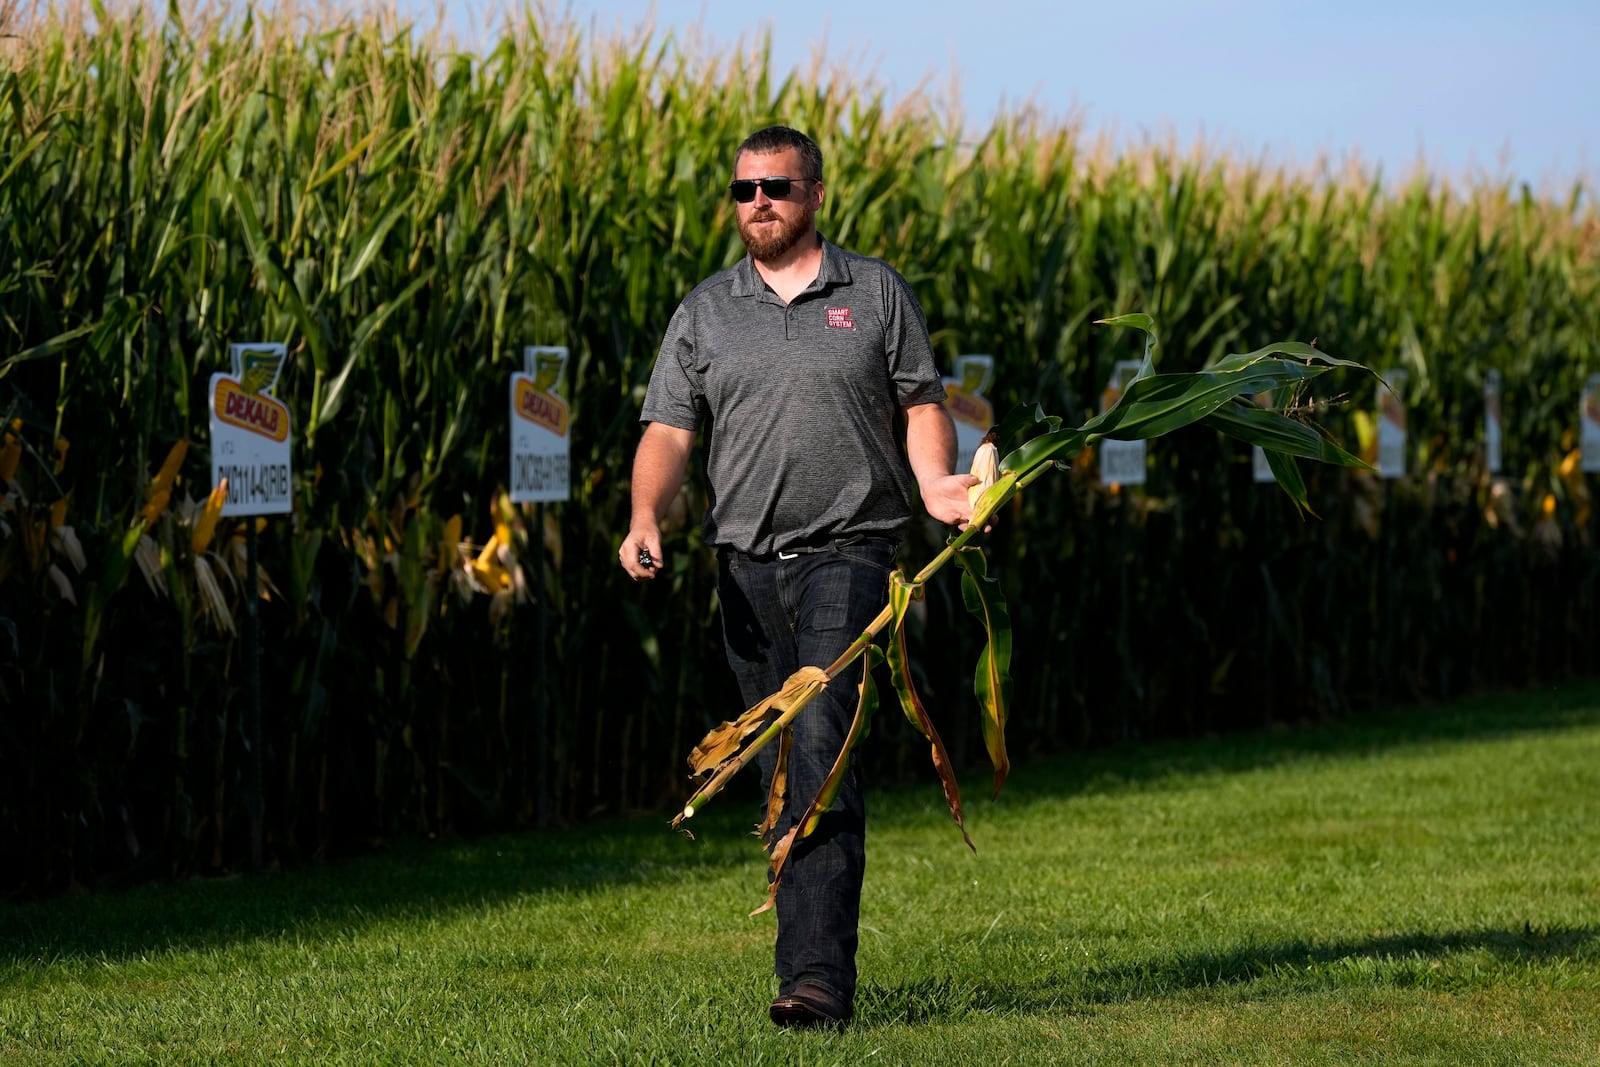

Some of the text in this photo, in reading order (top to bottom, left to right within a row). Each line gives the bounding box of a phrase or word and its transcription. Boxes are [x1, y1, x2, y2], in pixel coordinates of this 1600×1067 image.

[828, 308, 849, 316] SMART
[829, 320, 852, 328] SYSTEM
[225, 391, 279, 432] DEKALB
[522, 390, 561, 427] DEKALB
